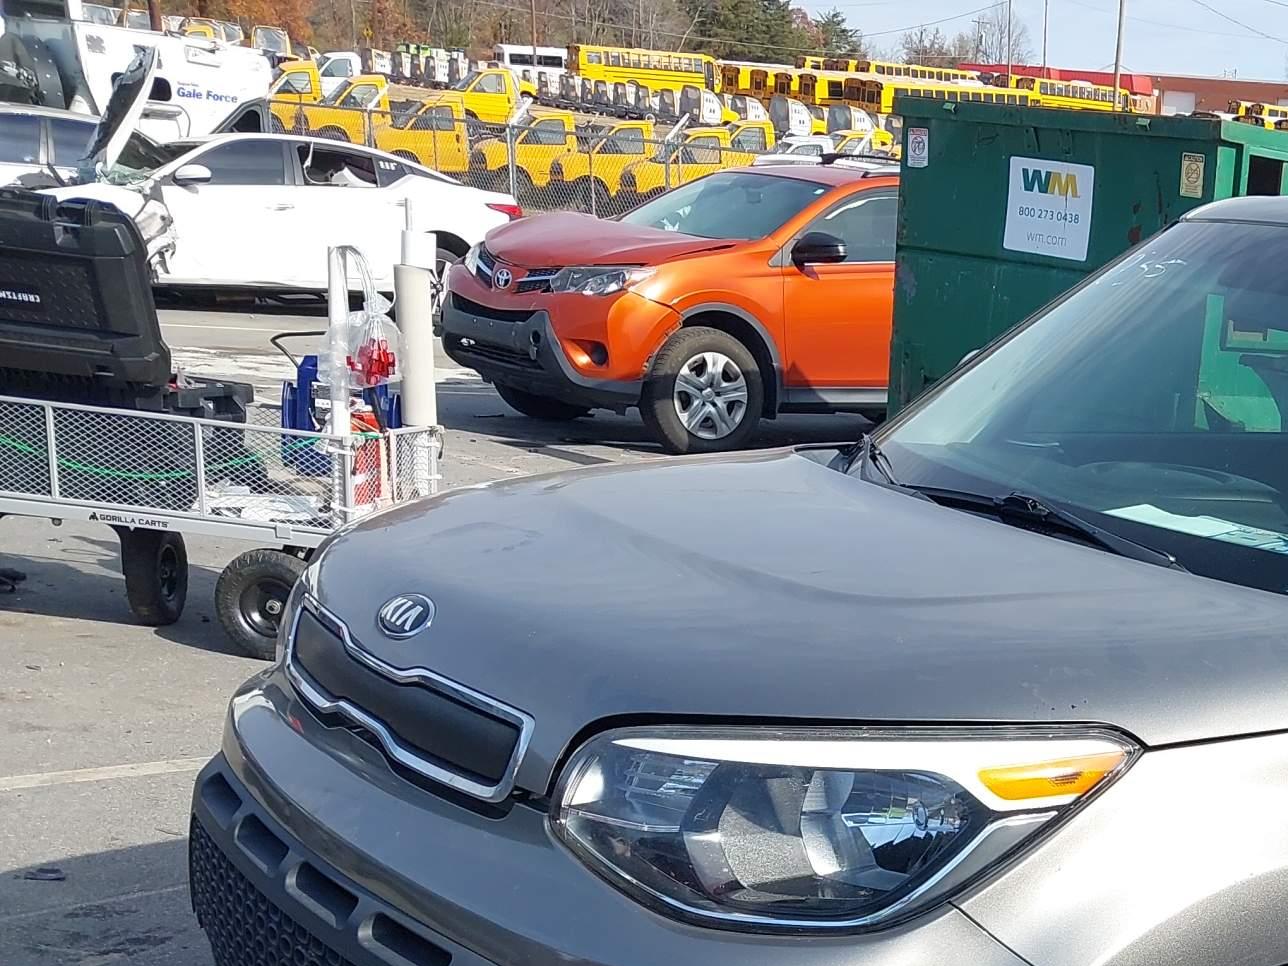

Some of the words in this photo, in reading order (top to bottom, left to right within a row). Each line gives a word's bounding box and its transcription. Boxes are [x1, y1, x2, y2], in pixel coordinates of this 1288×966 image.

[176, 86, 203, 99] Gale
[206, 90, 238, 103] Force
[1022, 167, 1079, 199] WM
[1018, 205, 1036, 218] 800
[1037, 208, 1055, 221] 273
[1056, 211, 1080, 224] 0438
[1026, 231, 1068, 247] wm.com
[99, 513, 137, 525] GORILLA
[138, 518, 169, 529] CARTS
[381, 597, 424, 631] KIA
